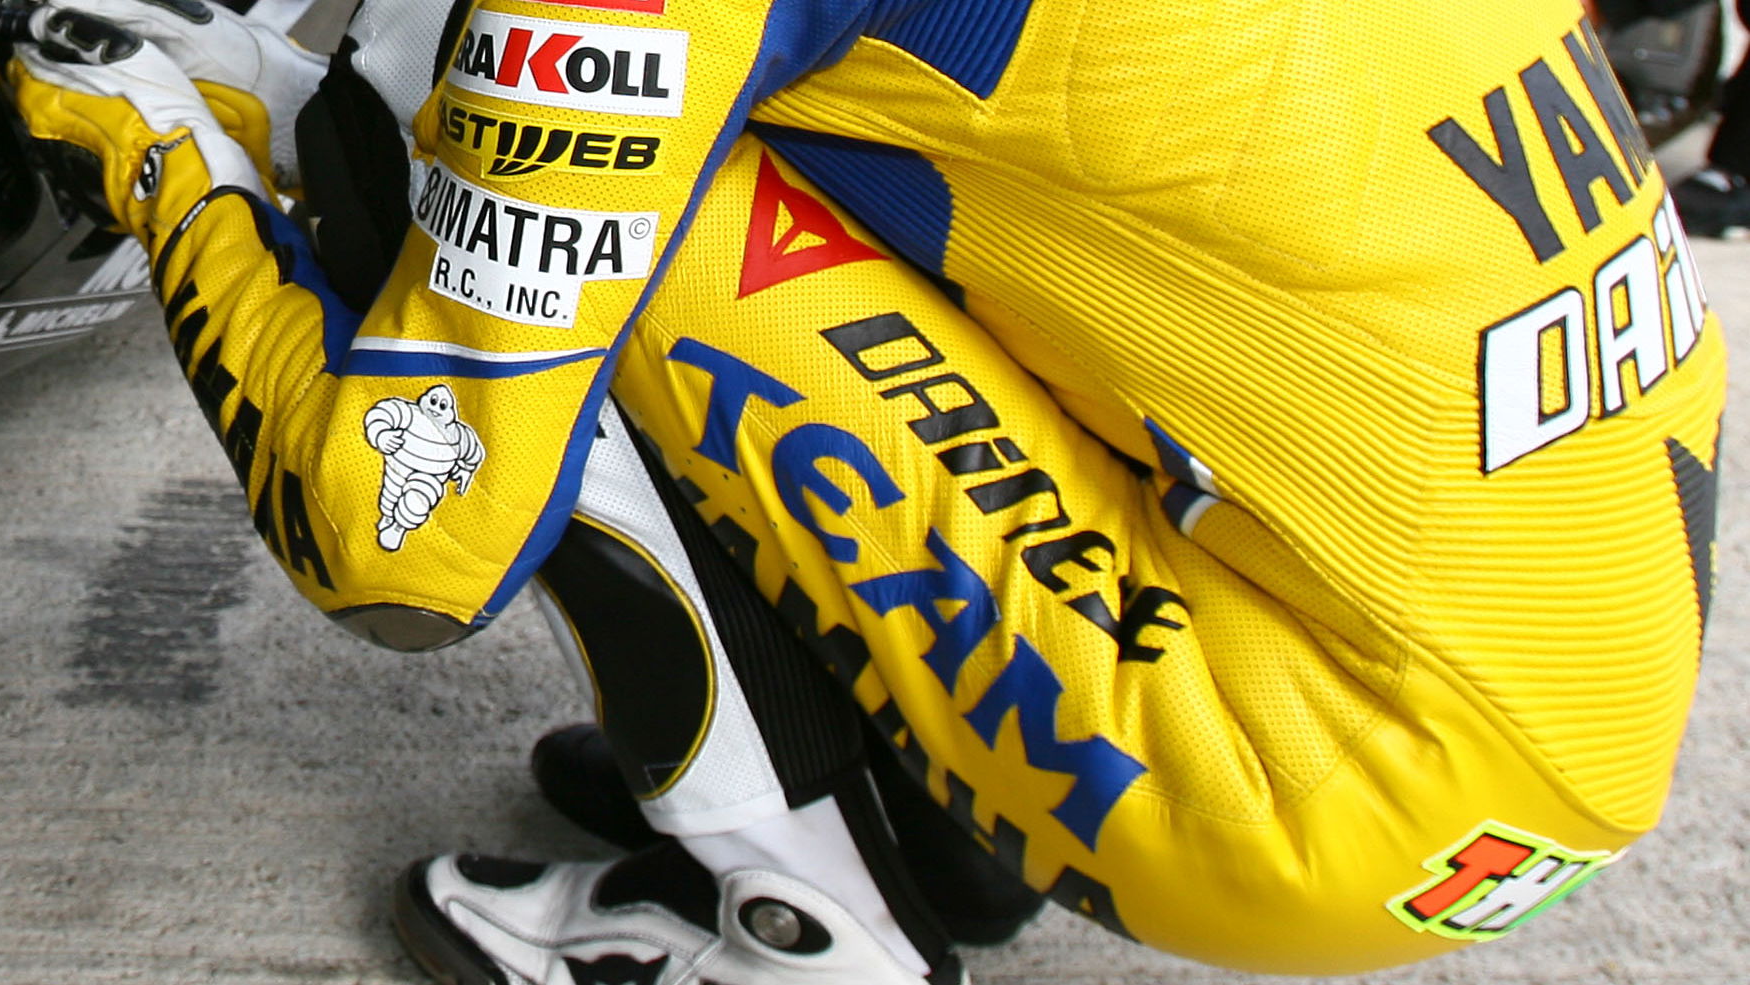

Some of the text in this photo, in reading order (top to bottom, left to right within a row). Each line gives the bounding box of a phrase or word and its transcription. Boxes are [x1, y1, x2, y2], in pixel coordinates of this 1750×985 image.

[452, 27, 670, 99] RAKOLL
[506, 283, 569, 321] INC.
[665, 336, 1149, 853] TEAM
